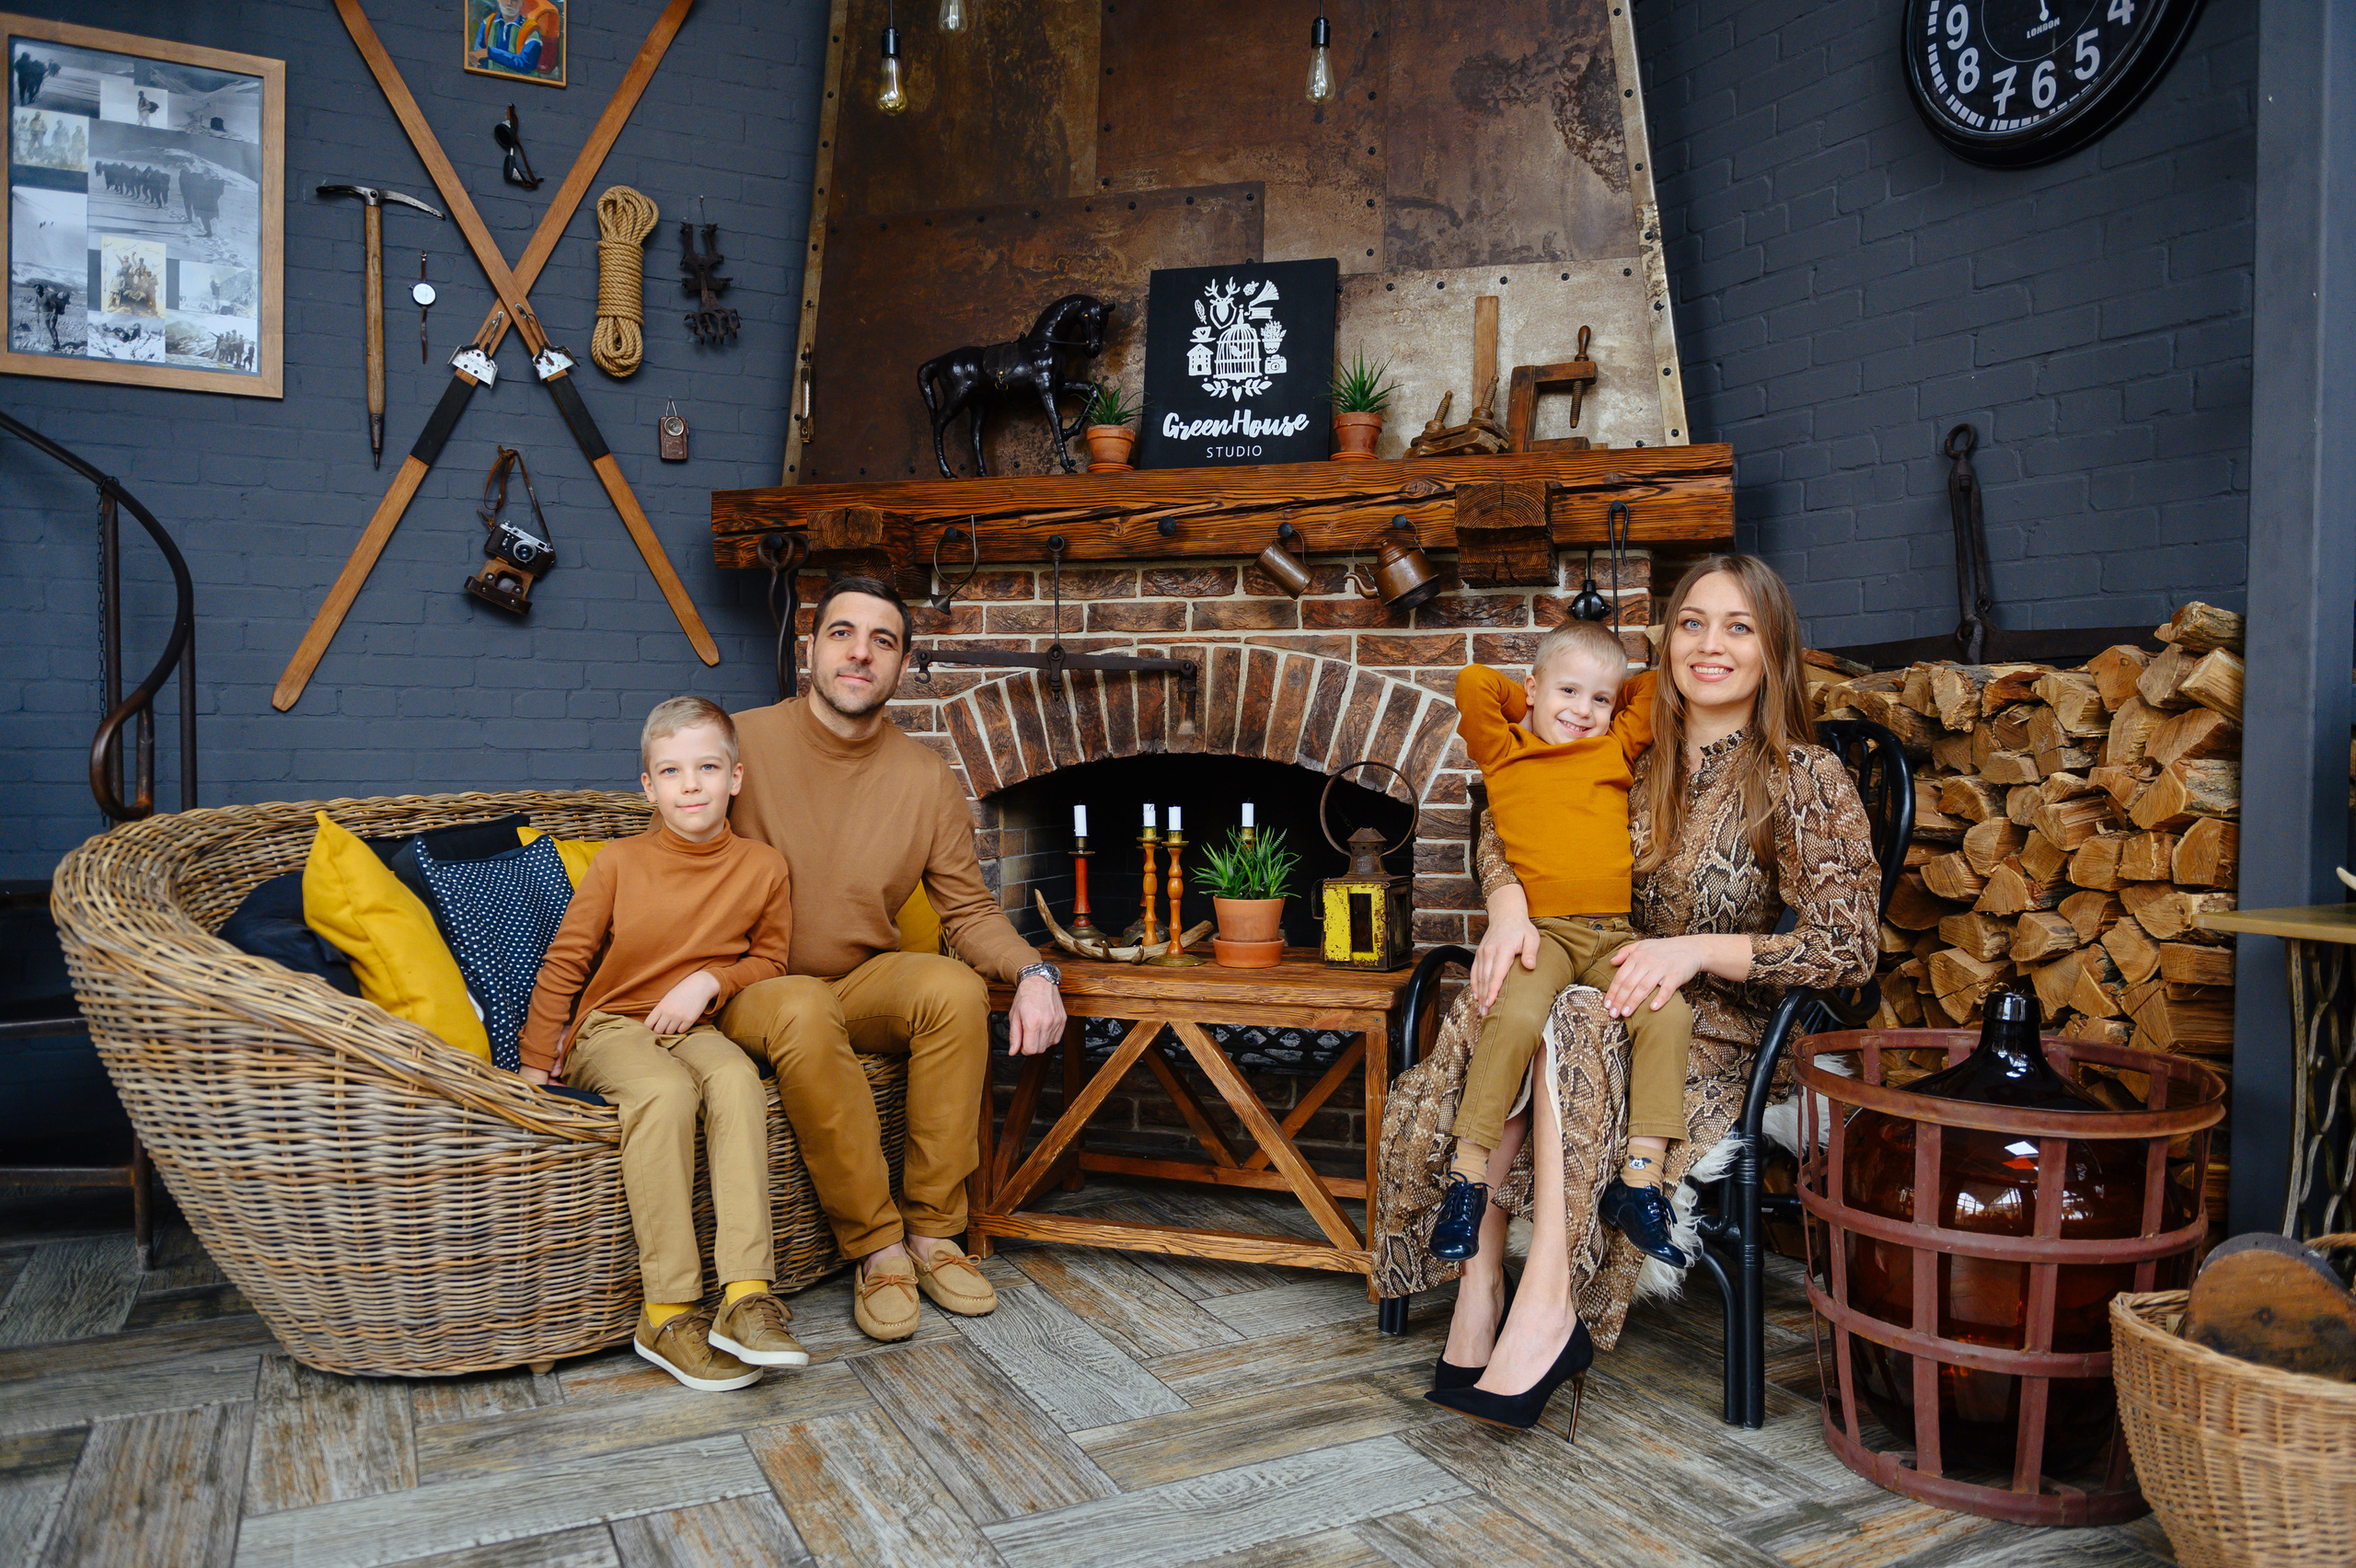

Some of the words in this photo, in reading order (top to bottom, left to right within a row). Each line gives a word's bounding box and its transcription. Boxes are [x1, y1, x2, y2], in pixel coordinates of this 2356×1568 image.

[1946, 4, 1969, 51] 9
[2027, 17, 2061, 40] LONDON
[1957, 47, 1981, 94] 8
[2073, 28, 2101, 81] 5
[1992, 65, 2017, 117] 7
[2031, 60, 2057, 110] 6
[1162, 409, 1311, 441] GreenHouse
[1206, 444, 1263, 458] STUDIO
